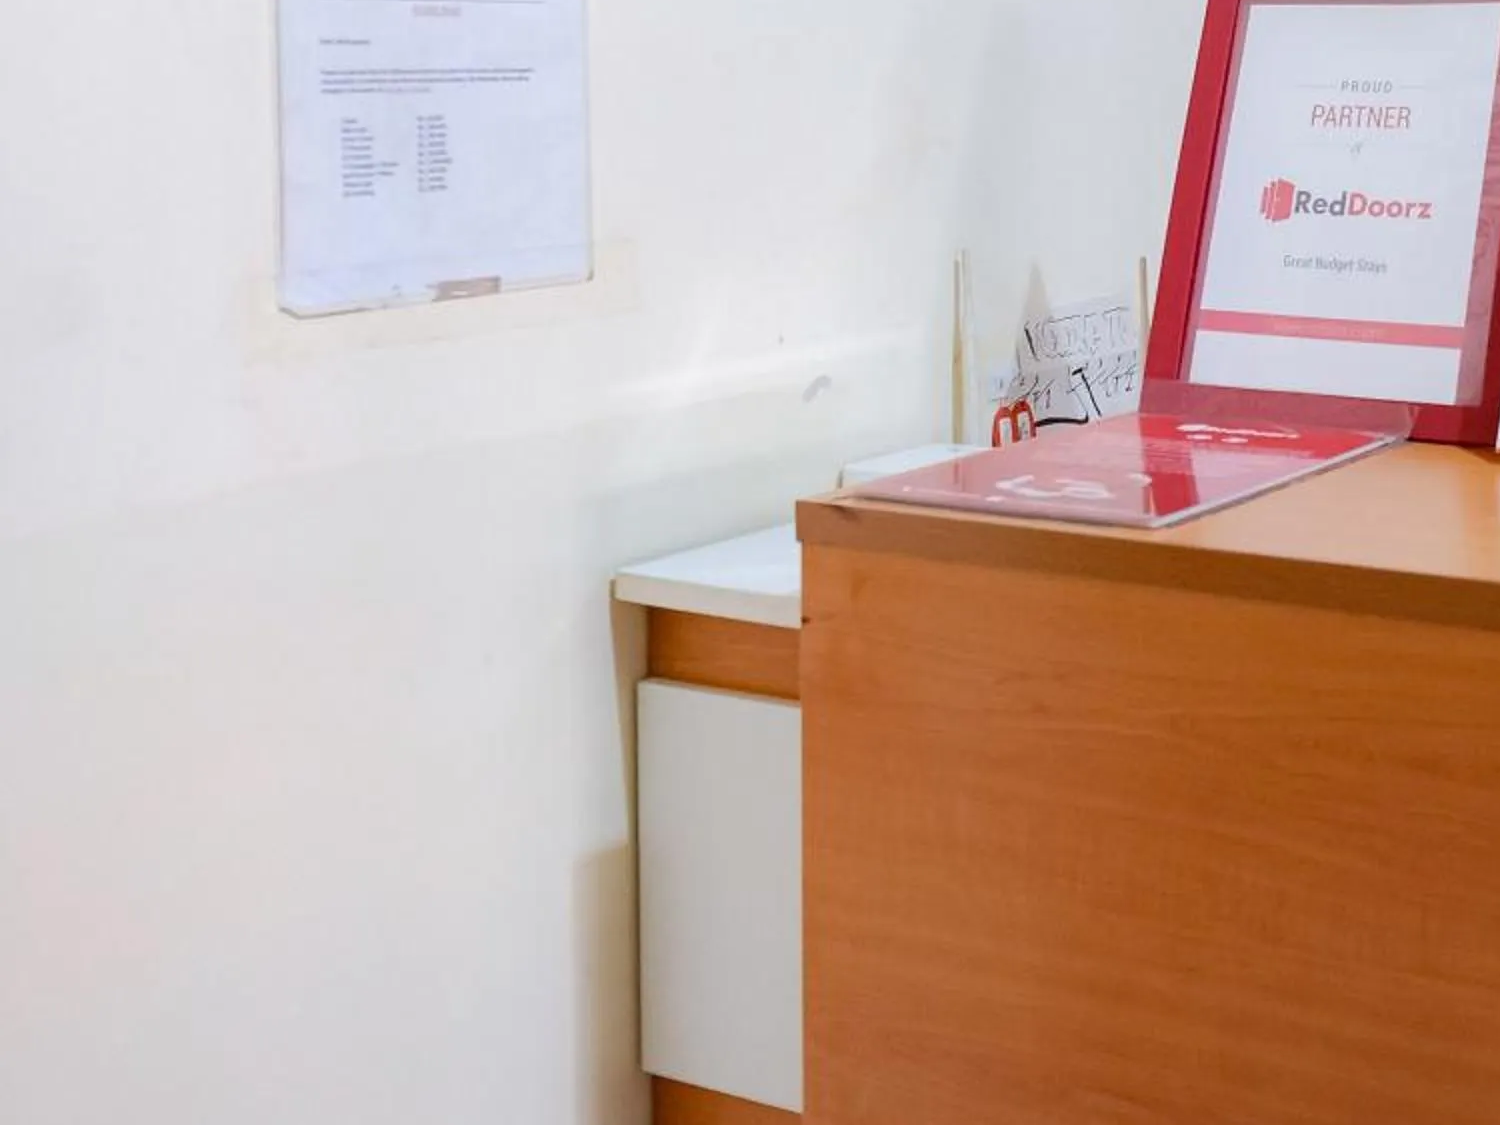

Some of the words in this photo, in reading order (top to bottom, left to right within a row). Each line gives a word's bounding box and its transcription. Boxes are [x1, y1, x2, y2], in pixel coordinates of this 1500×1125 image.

[1341, 79, 1393, 94] PROUD
[1311, 104, 1411, 129] PARTNER
[1294, 190, 1433, 219] RedDoorz
[1283, 254, 1313, 268] Great
[1316, 257, 1352, 273] Budget
